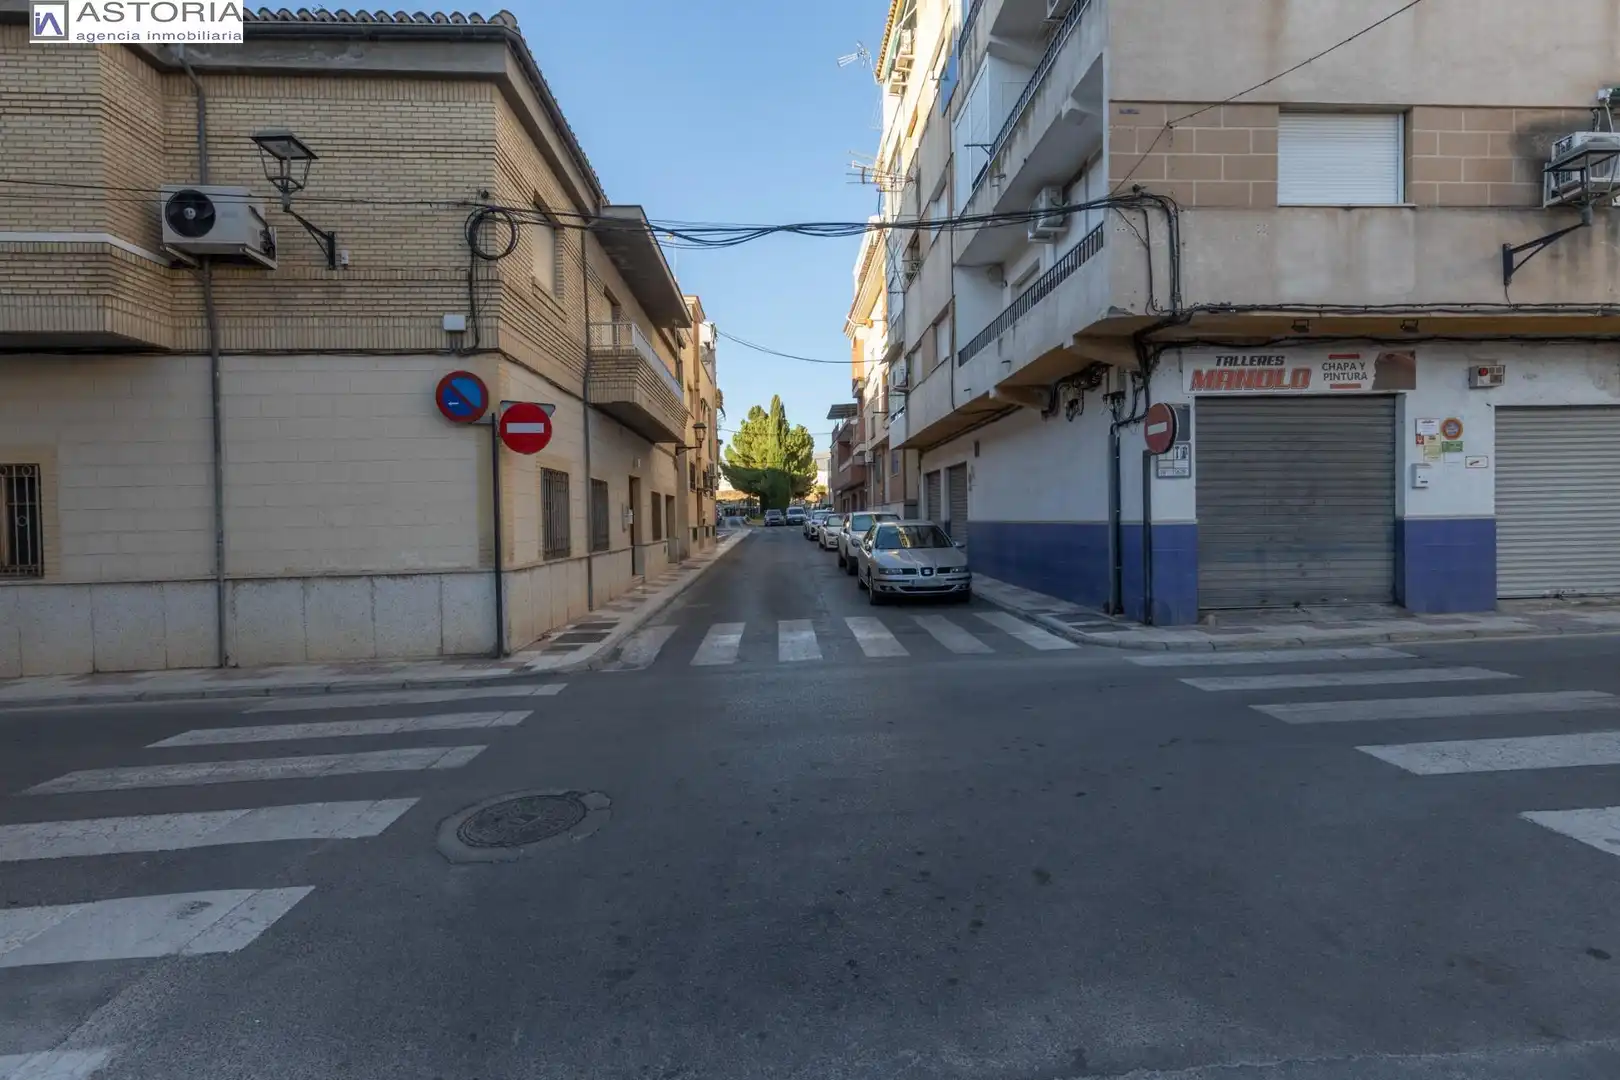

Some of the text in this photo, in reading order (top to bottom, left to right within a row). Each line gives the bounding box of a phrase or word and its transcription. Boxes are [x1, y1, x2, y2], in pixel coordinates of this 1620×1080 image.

[1215, 355, 1285, 366] TALLERES
[1322, 362, 1366, 371] CHAPA Y
[1189, 368, 1312, 391] MANOLO
[1323, 372, 1368, 380] PINTURA
